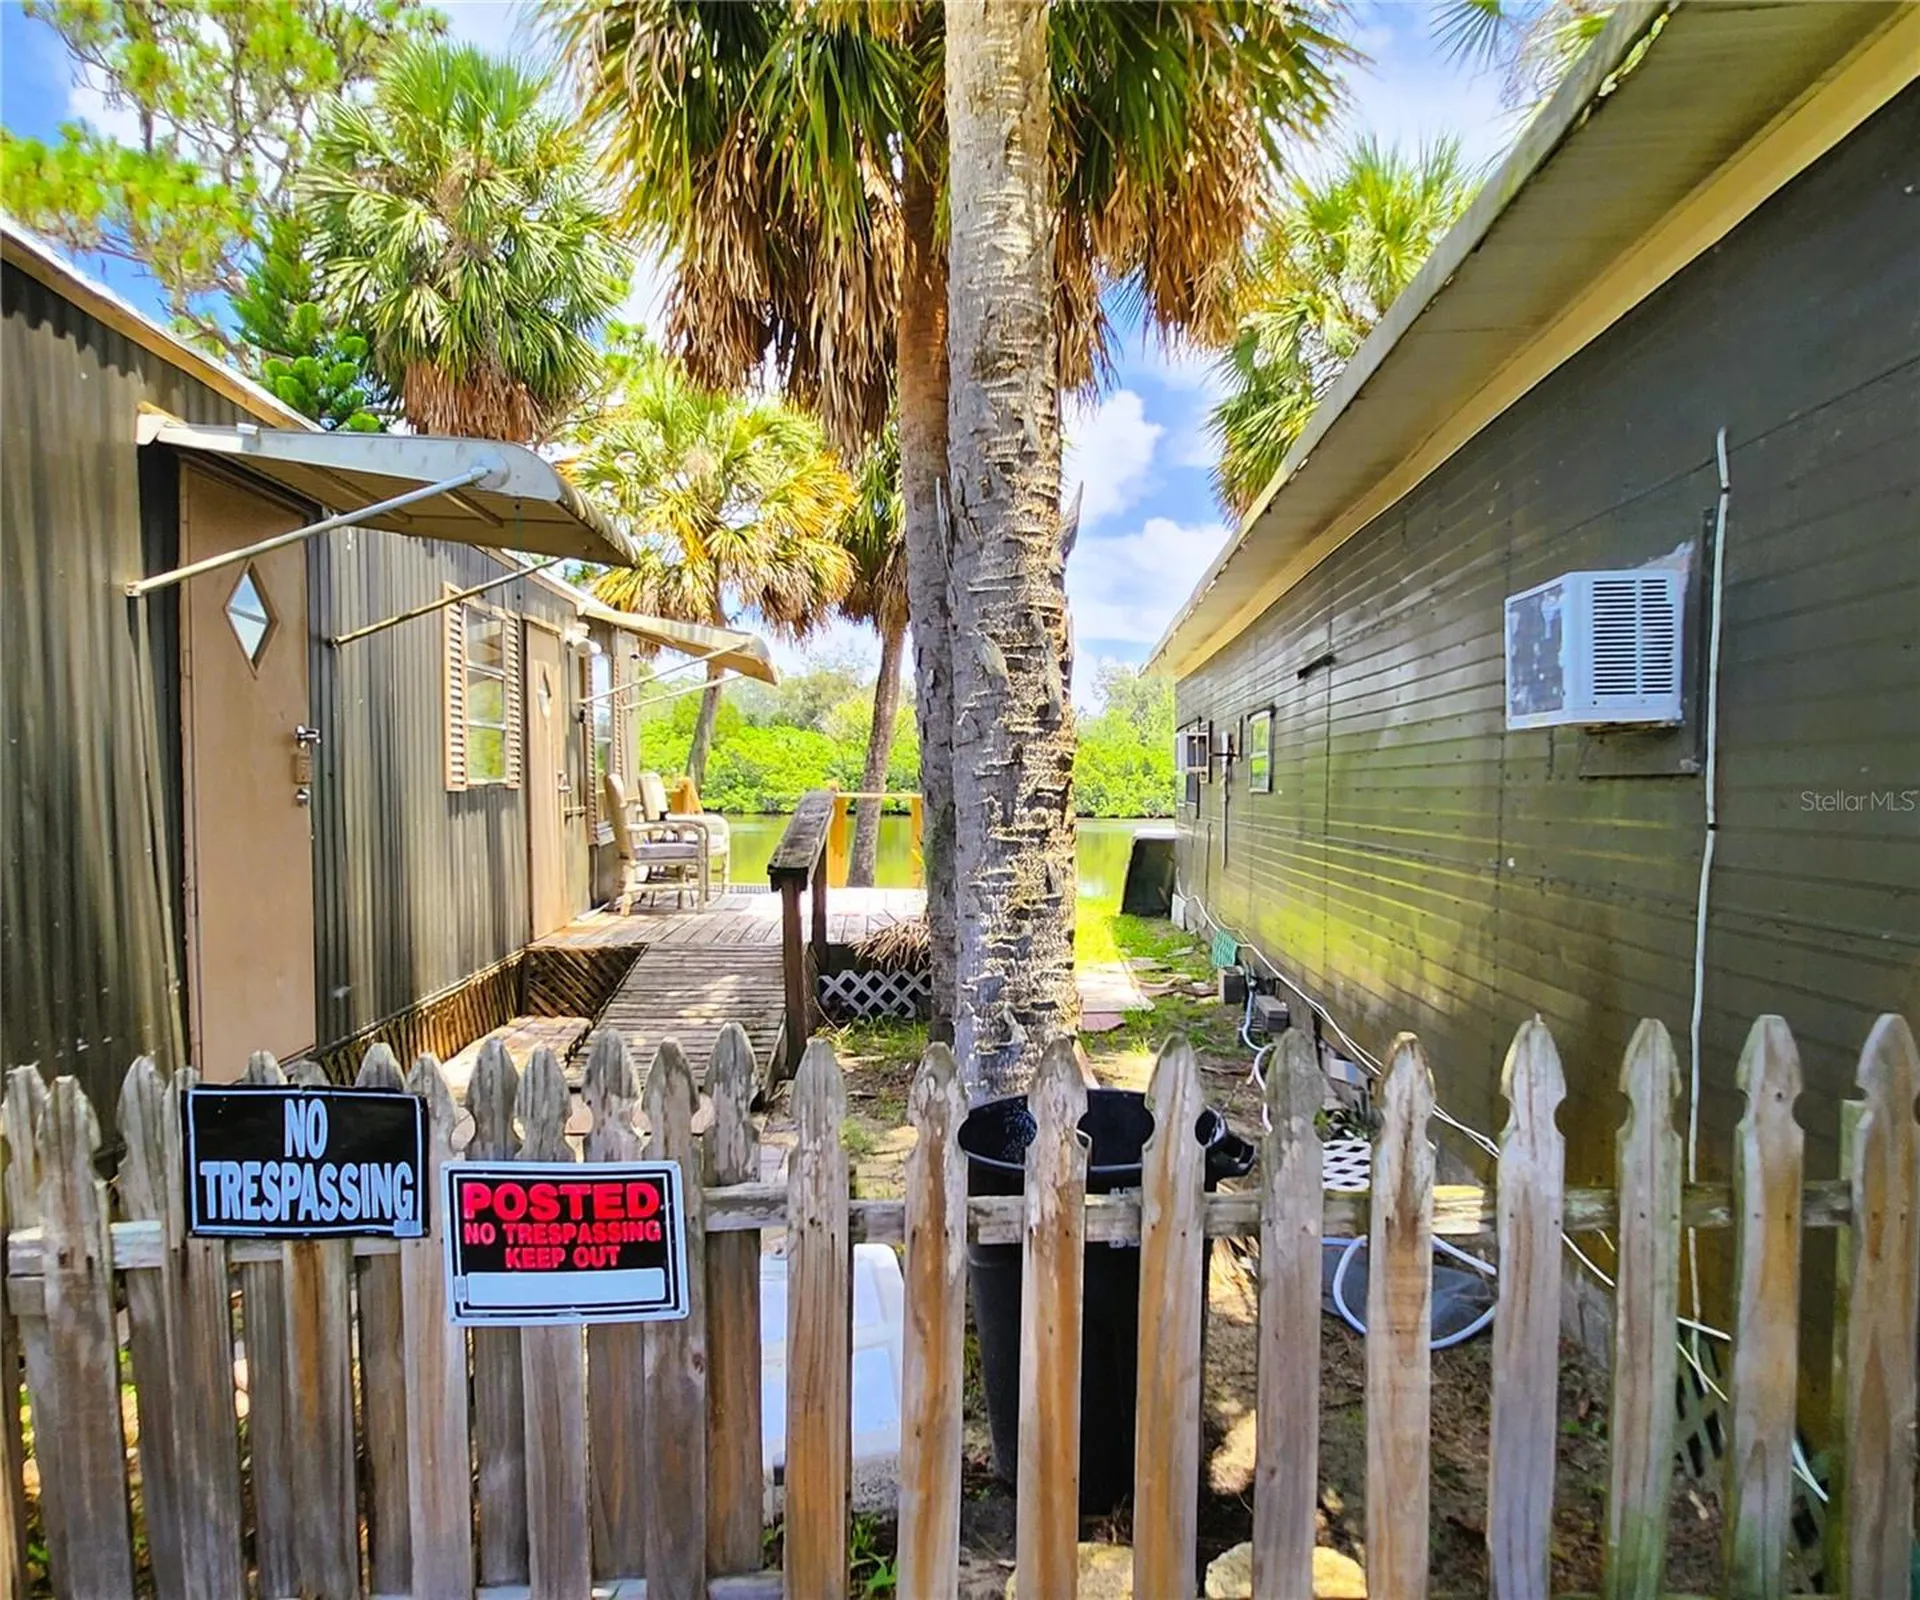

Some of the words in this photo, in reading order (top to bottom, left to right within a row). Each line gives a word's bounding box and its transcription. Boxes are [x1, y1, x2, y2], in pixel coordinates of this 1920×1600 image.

[284, 1098, 329, 1160] NO
[199, 1160, 414, 1222] TRESPASSING
[462, 1181, 661, 1221] POSTED
[464, 1222, 496, 1245] NO
[502, 1219, 662, 1246] TRESPASSING
[504, 1246, 566, 1269] KEEP
[573, 1245, 621, 1268] OUT
